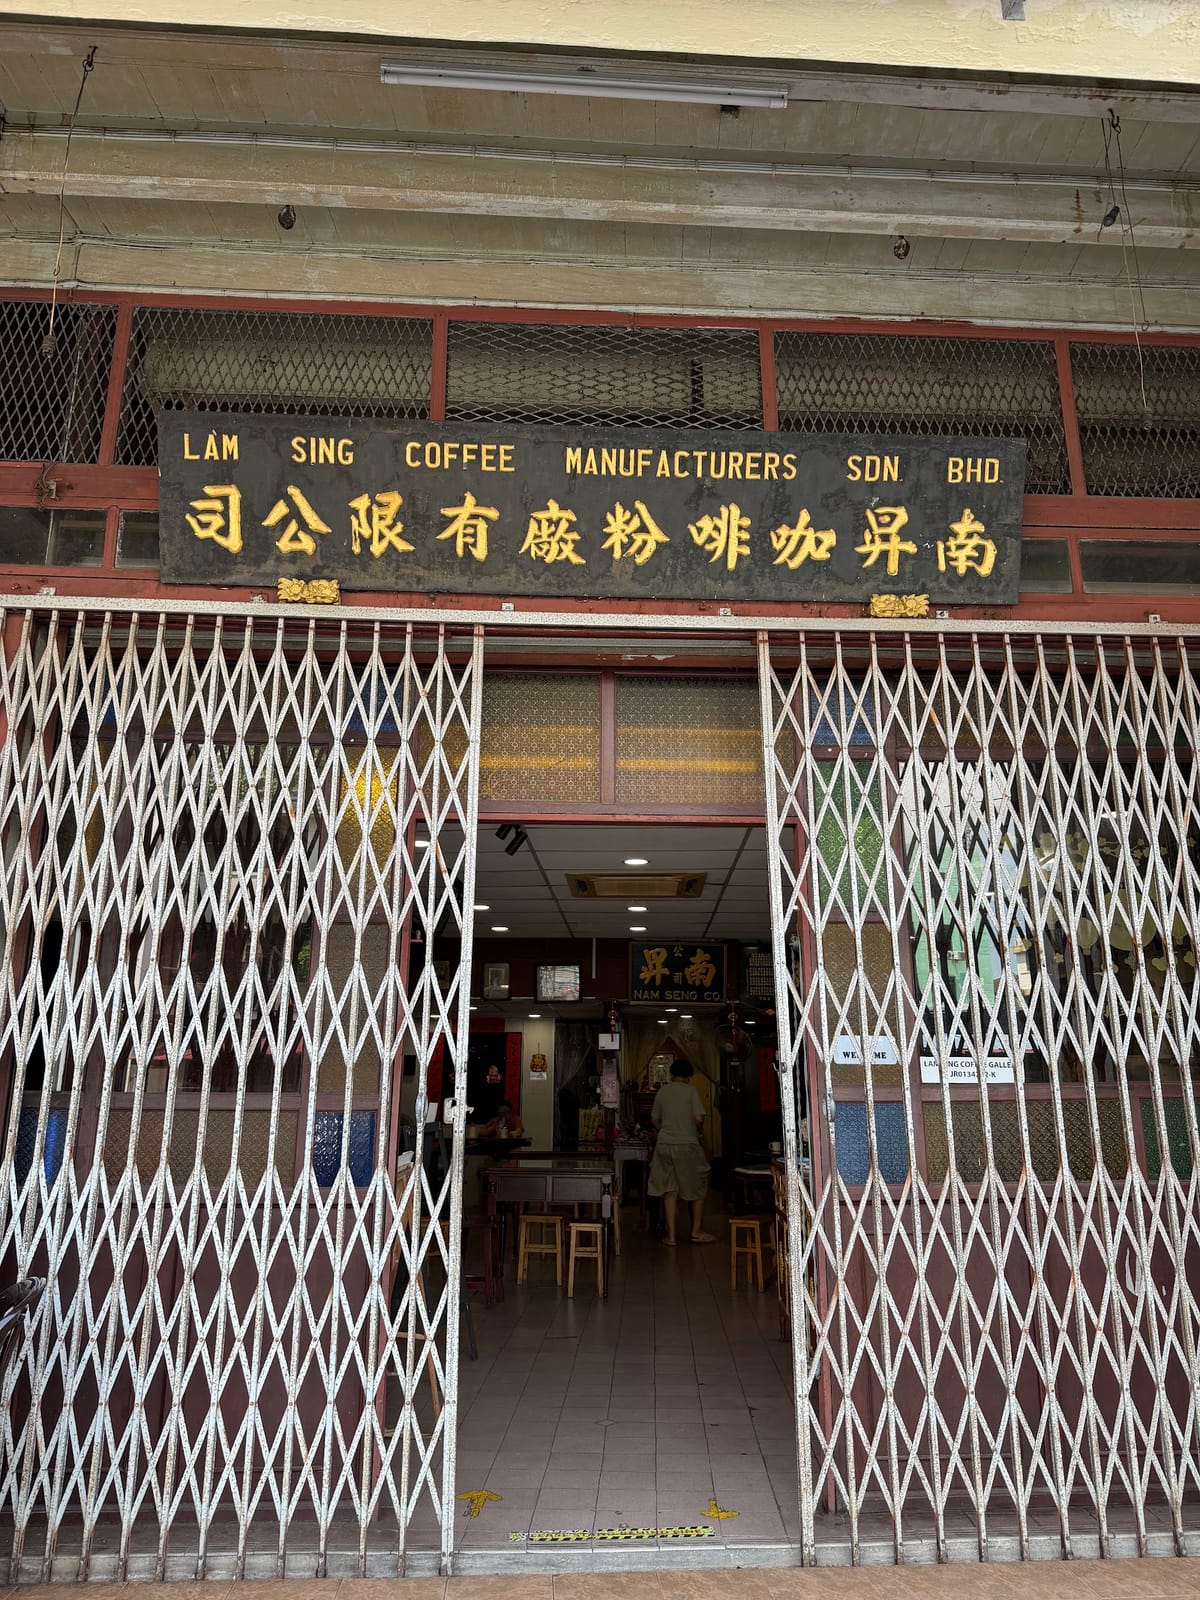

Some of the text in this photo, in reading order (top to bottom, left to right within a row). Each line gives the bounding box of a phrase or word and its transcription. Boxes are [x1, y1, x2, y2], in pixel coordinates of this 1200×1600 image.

[291, 436, 354, 465] SING
[405, 441, 515, 472] COFFEE
[565, 448, 798, 480] MANUFACTURERS
[633, 989, 720, 1000] NAM SENG CO
[842, 1051, 887, 1059] WEME
[960, 1060, 988, 1068] COFE
[988, 1061, 1014, 1069] GALLE
